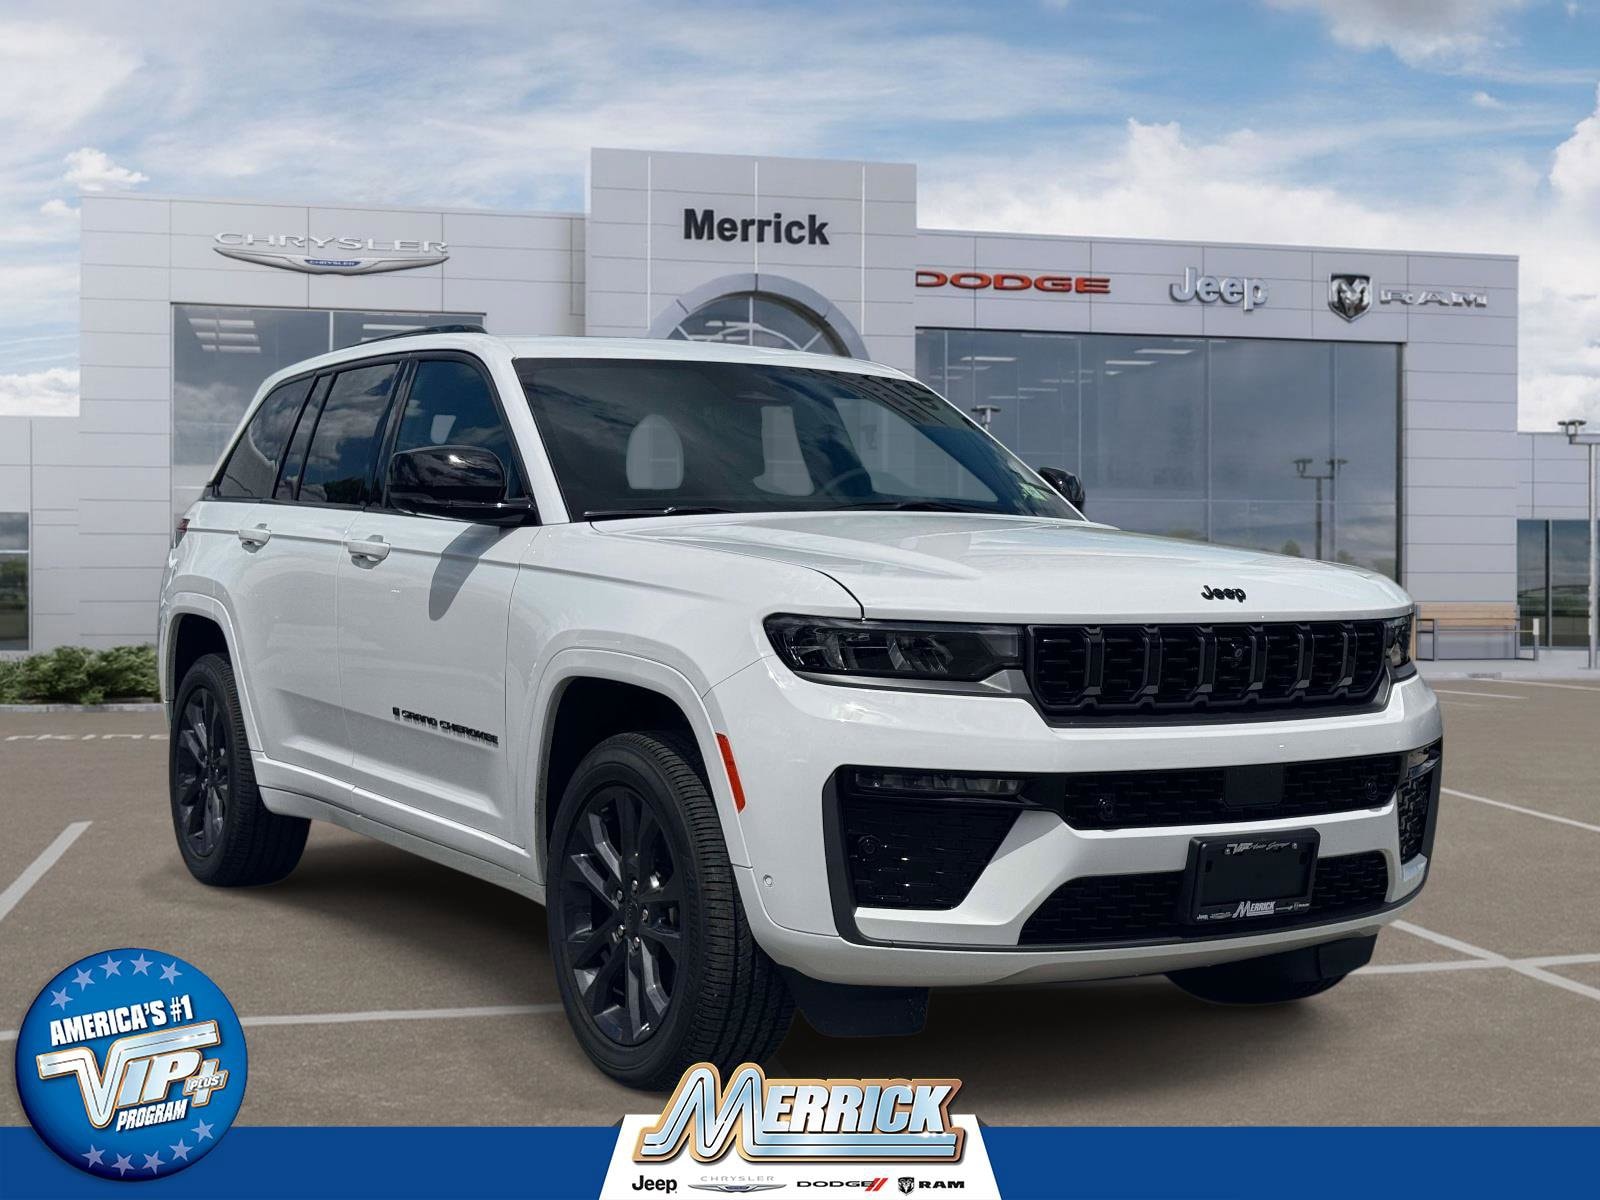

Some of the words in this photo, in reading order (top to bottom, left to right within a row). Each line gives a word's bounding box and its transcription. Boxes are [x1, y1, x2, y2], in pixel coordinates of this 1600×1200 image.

[683, 208, 830, 246] Merrick
[214, 232, 449, 254] CHRYSLER
[915, 271, 1111, 293] DODGE
[1169, 267, 1269, 312] Jeep
[1380, 290, 1488, 307] RAM
[1200, 584, 1247, 603] Jeep
[1232, 900, 1276, 918] MERRICK
